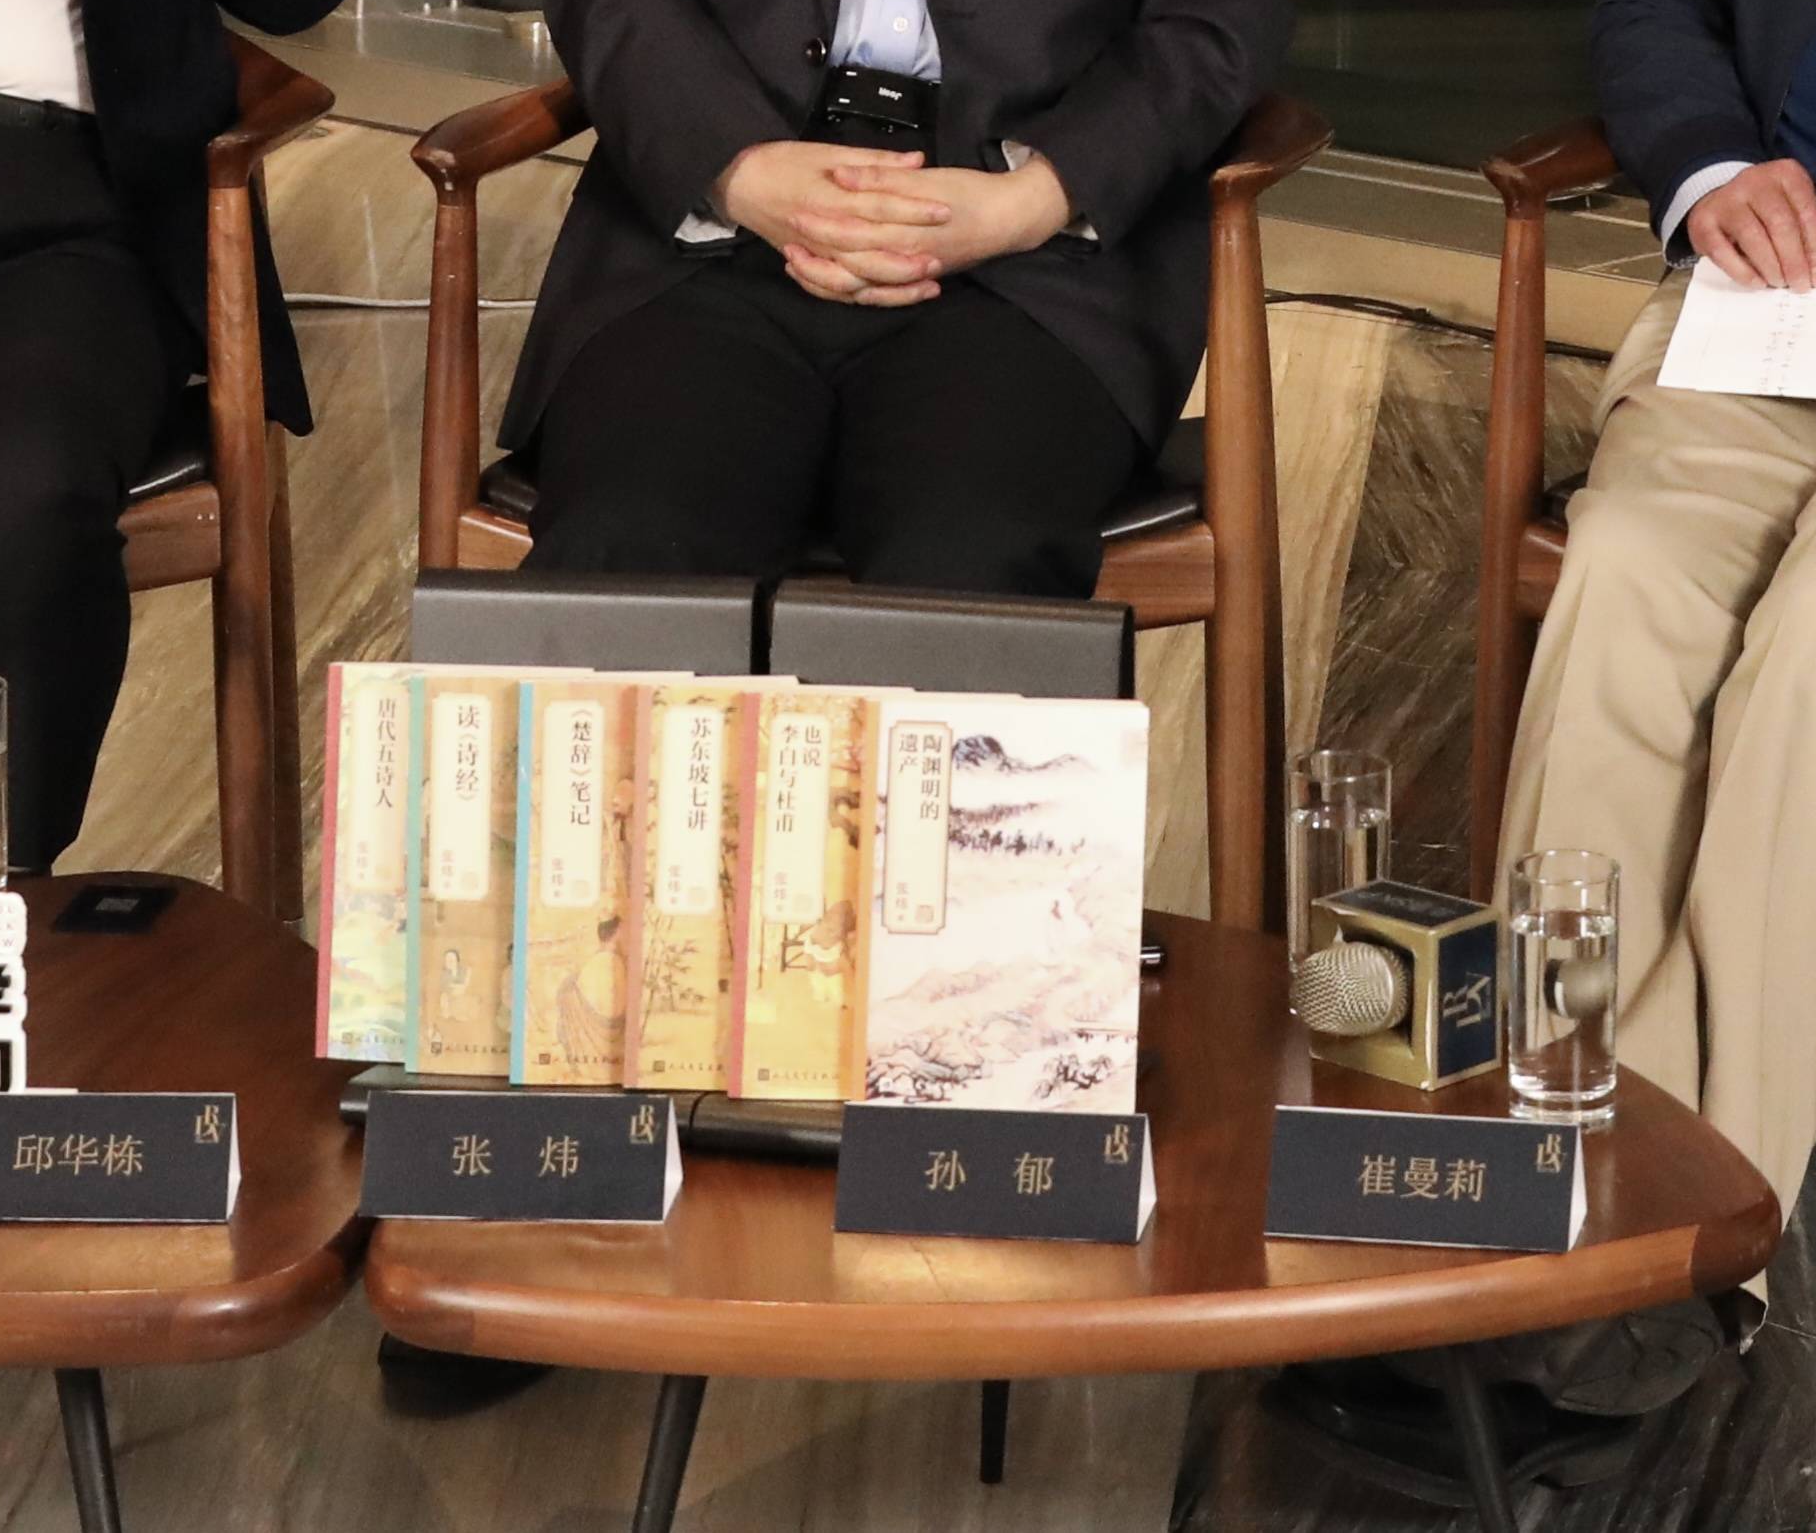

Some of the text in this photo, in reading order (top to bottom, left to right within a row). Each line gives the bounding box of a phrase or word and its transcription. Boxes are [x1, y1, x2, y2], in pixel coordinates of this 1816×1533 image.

[375, 698, 397, 809] 唐代五诗人
[686, 716, 711, 832] 苏东坡七讲
[12, 1133, 145, 1177] 邱华栋
[450, 1134, 580, 1179] 张炜
[924, 1150, 1055, 1196] 孙郁
[1357, 1154, 1487, 1202] 崔曼莉
